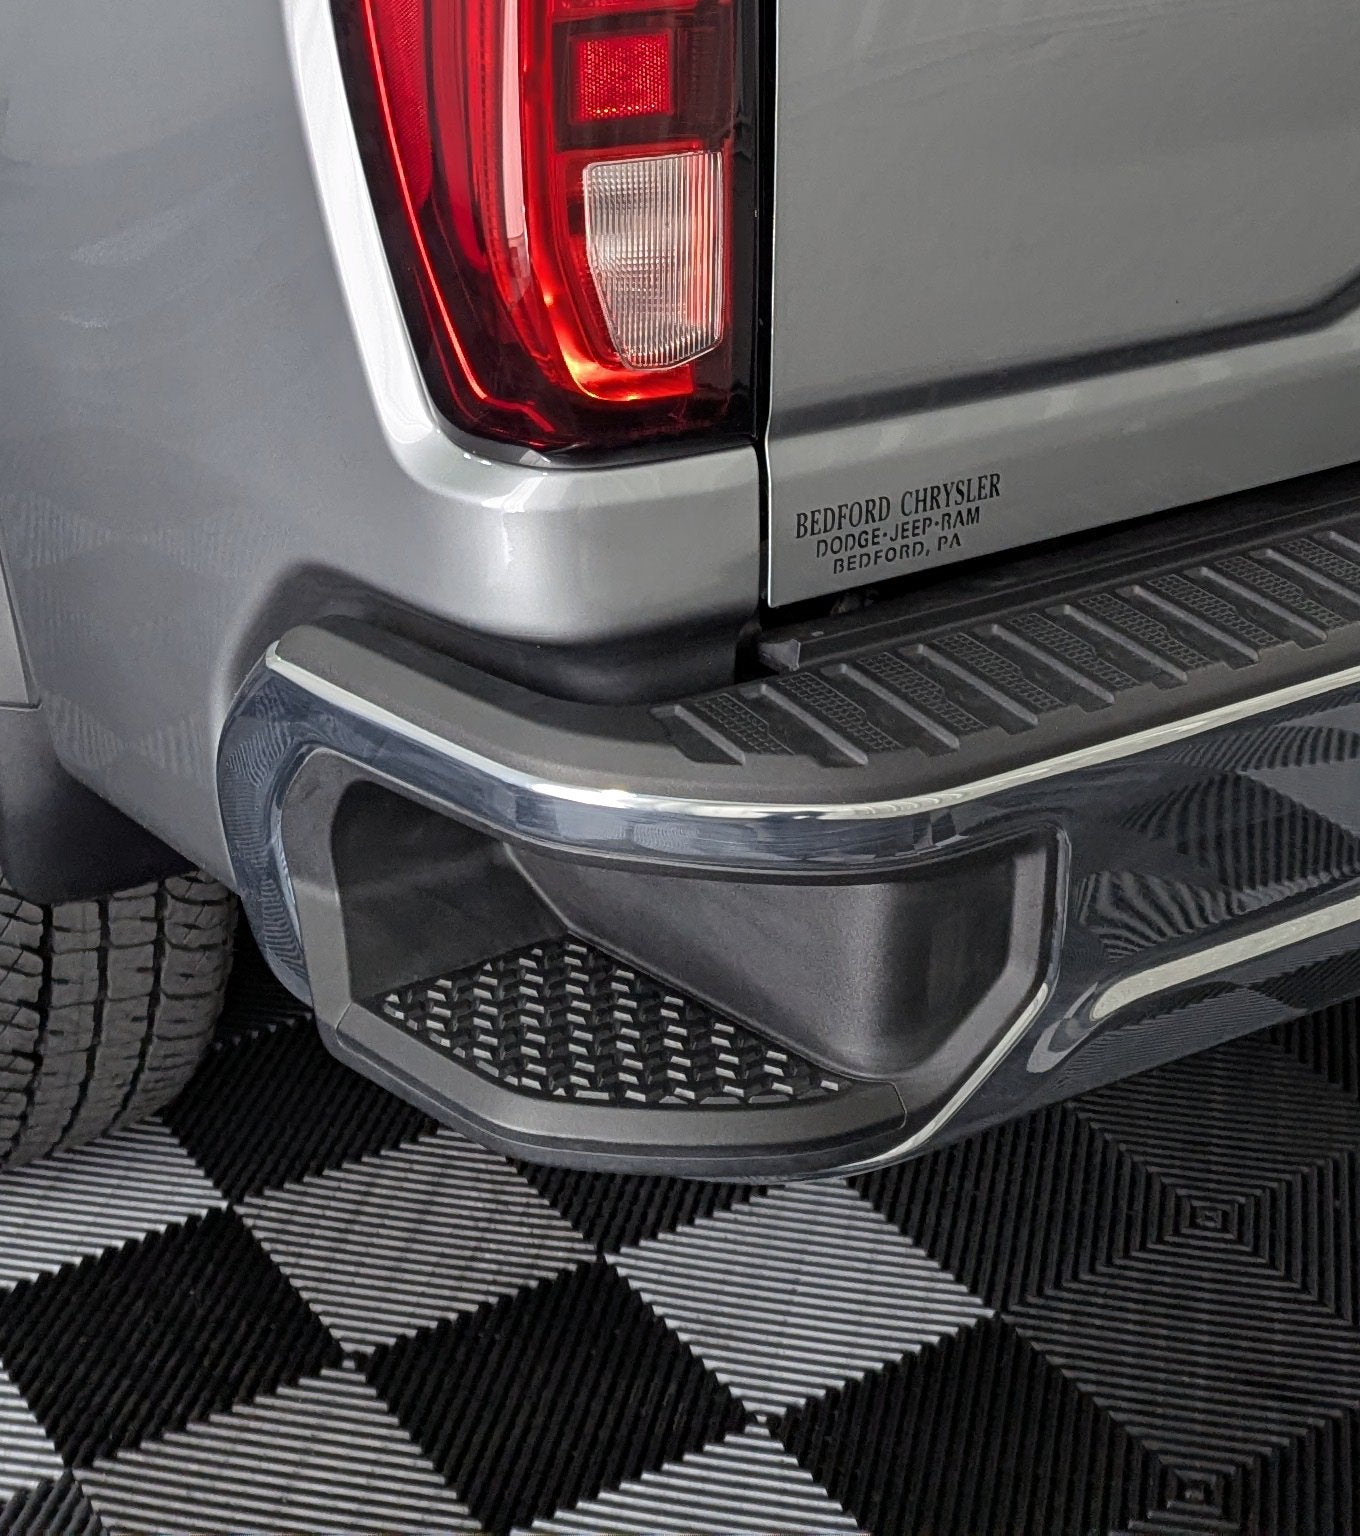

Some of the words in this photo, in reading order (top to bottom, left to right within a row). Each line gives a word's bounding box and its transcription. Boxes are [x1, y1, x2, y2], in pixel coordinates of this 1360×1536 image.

[796, 496, 891, 539] BEDFORD
[901, 473, 1001, 516] CHRYSLER
[833, 541, 930, 574] BEDFORD,
[937, 533, 962, 552] PA
